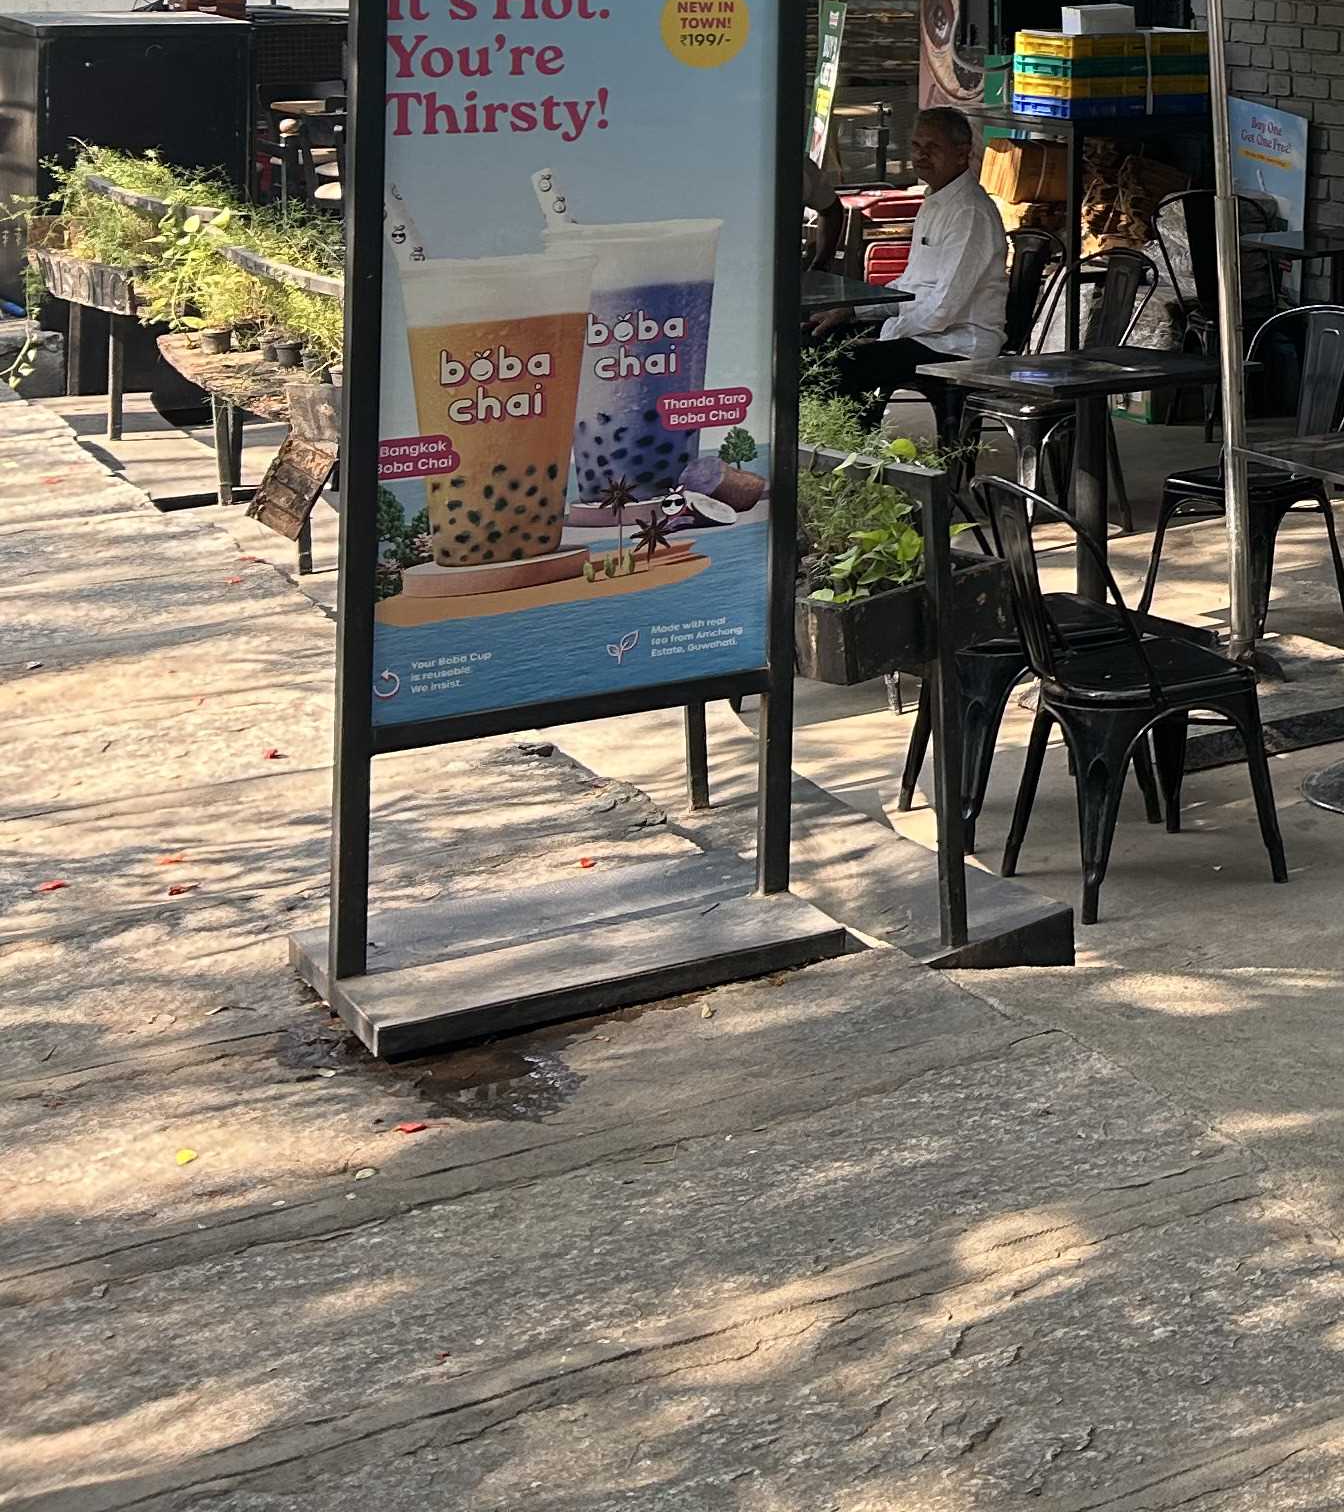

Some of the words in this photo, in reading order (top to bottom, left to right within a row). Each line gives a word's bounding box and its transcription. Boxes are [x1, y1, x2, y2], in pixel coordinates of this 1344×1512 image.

[676, 1, 713, 14] NEW
[718, 1, 735, 13] IN
[680, 17, 732, 30] TOWN!
[680, 33, 732, 47] ₹199/-
[385, 87, 609, 143] Thirsty!
[586, 310, 687, 346] boba
[438, 345, 553, 386] boba
[592, 344, 680, 381] chai
[447, 383, 545, 425] chai
[662, 395, 715, 411] Thanda
[718, 392, 748, 407] Taro
[669, 410, 705, 426] Boba
[708, 407, 741, 422] Chai
[379, 439, 447, 459] Bangkok
[417, 456, 453, 471] Chai
[670, 632, 694, 644] from
[438, 654, 468, 667] Boba
[469, 651, 493, 663] Cup
